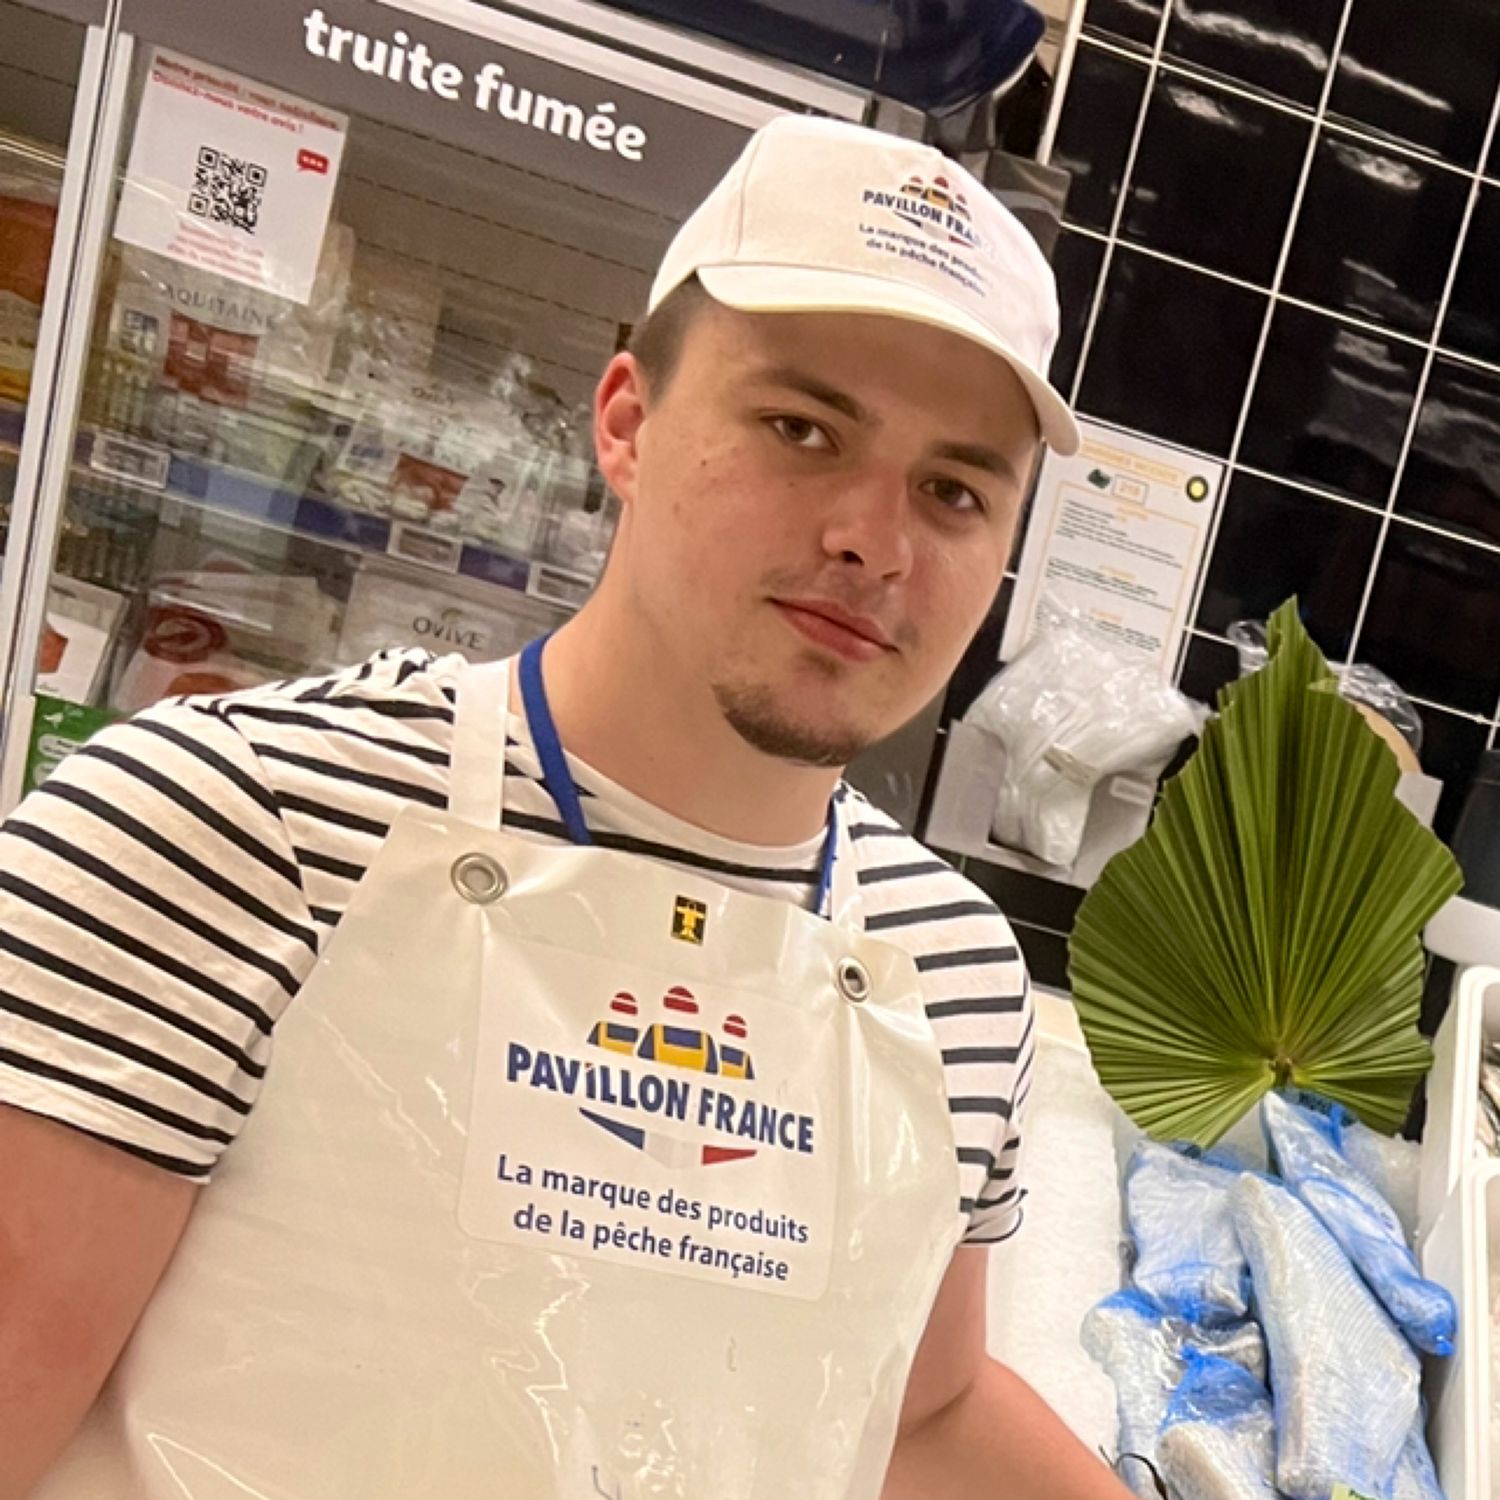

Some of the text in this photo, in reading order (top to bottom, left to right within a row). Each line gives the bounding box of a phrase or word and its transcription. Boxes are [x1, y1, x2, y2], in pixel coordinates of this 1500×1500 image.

[303, 8, 647, 160] truite fumée
[507, 1041, 815, 1154] PAVILLON FRANCE
[497, 1154, 810, 1244] La marque des produits
[513, 1202, 790, 1280] de la pêche française
